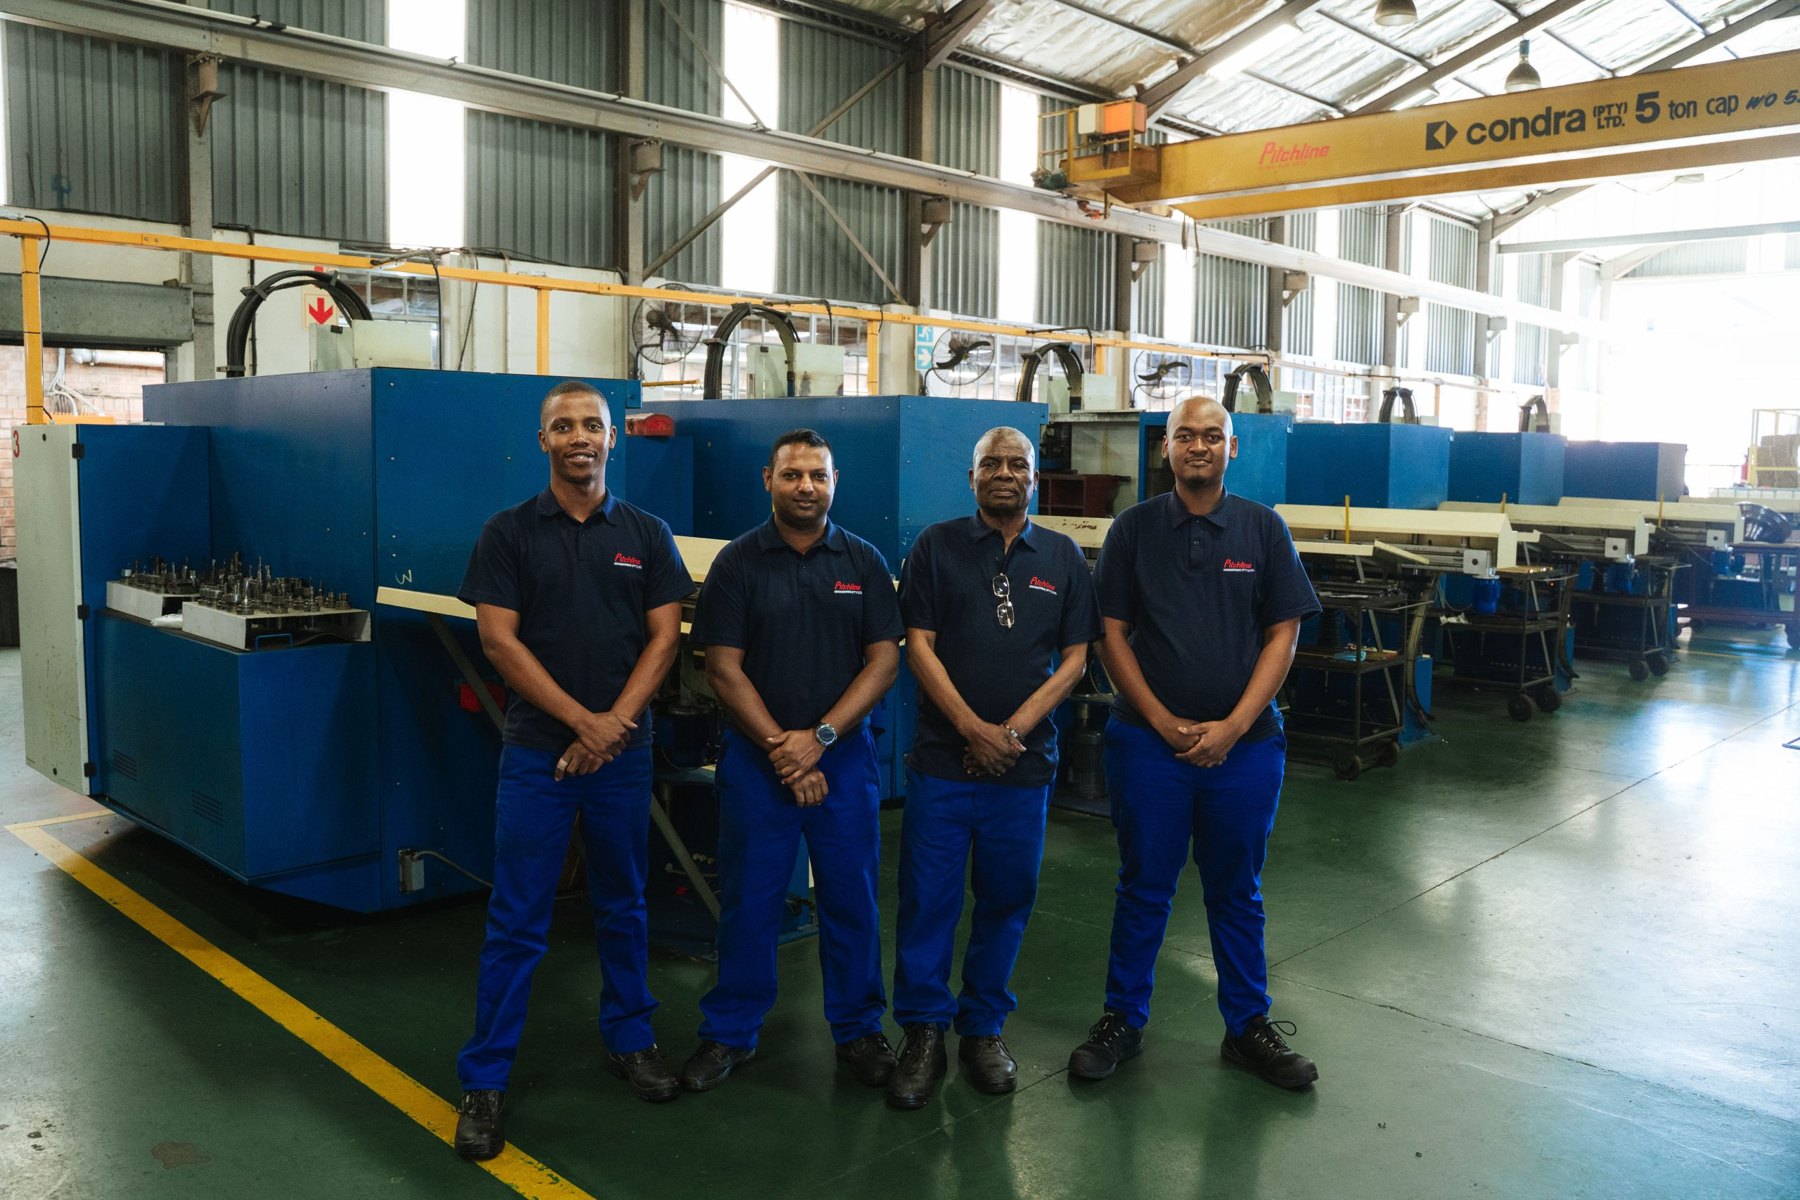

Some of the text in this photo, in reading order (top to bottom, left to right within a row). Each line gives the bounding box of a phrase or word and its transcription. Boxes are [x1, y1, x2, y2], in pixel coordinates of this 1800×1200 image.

[1466, 105, 1586, 145] condra
[1635, 91, 1661, 124] 5
[1668, 100, 1698, 120] ton
[1706, 94, 1740, 117] cap
[1258, 141, 1329, 165] Pitchline
[13, 429, 20, 458] 3
